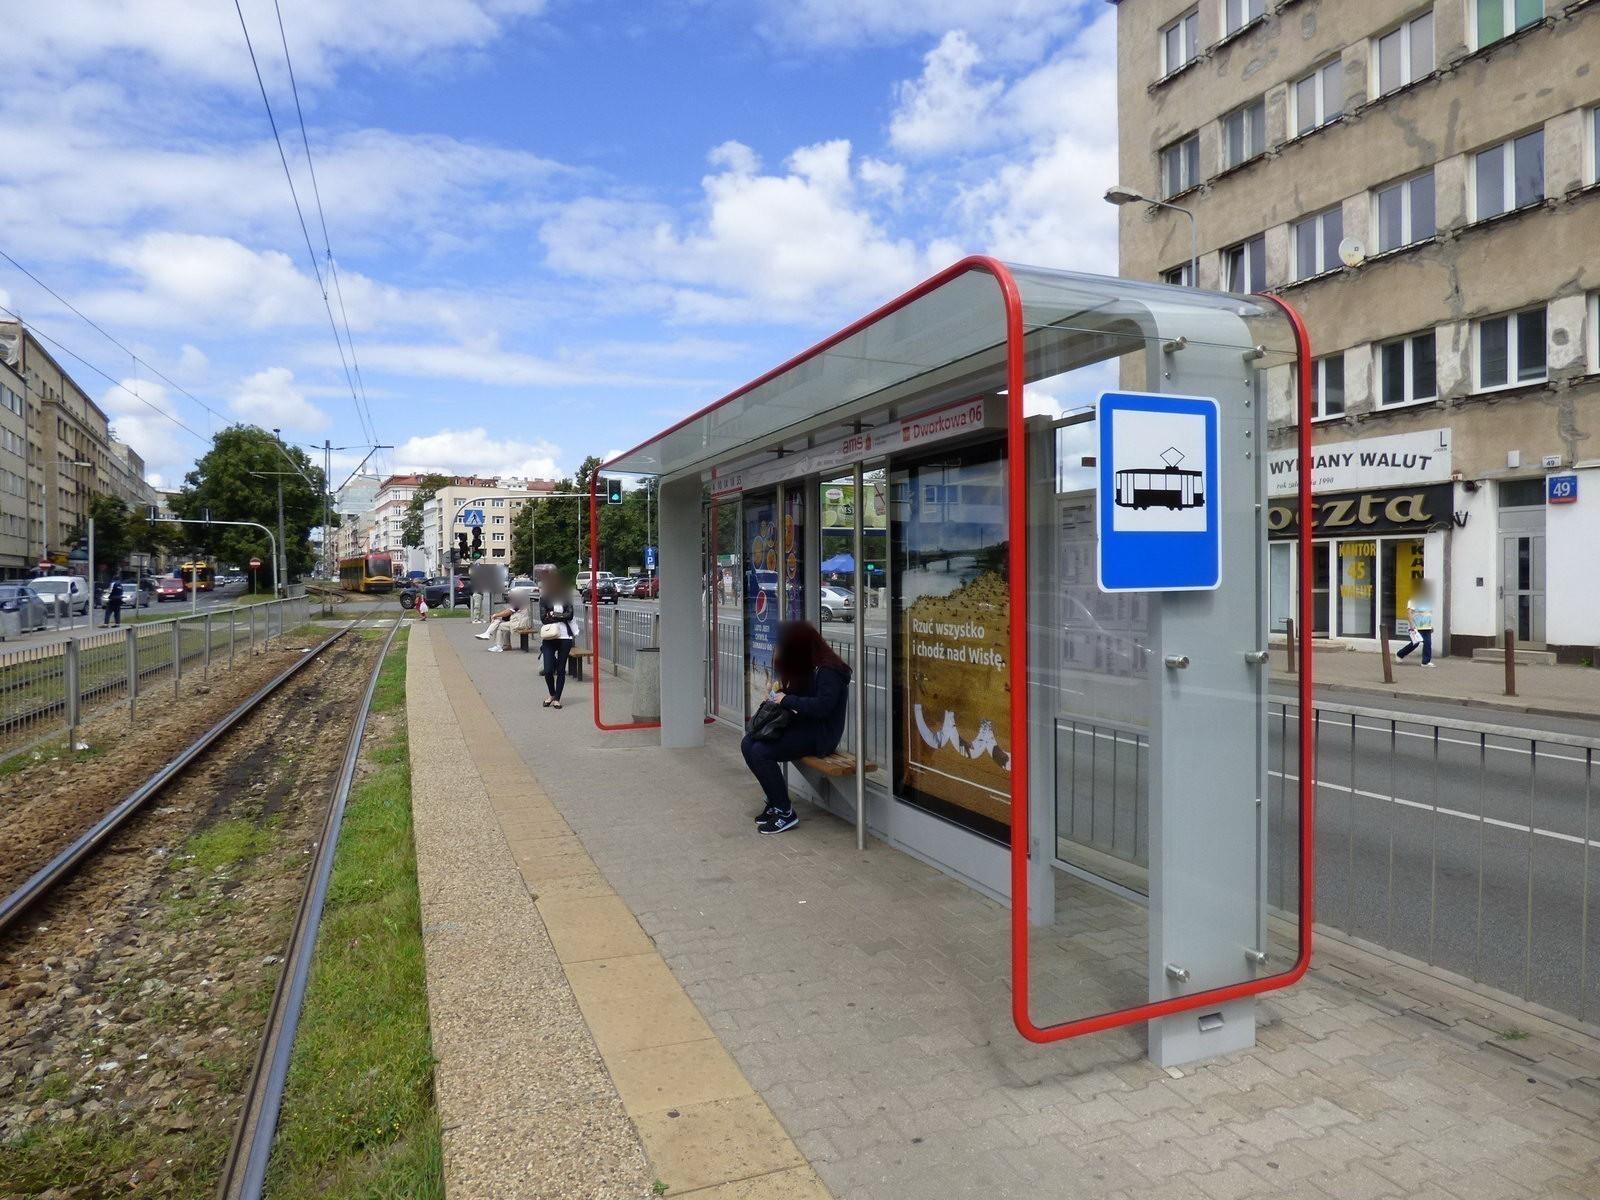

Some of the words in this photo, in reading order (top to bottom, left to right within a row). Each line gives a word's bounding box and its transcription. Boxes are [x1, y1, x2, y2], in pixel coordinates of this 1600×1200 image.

[913, 414, 967, 439] Dworkowa
[968, 405, 982, 424] 06
[842, 436, 863, 454] ams
[1270, 453, 1354, 475] WYIANY
[1360, 452, 1432, 471] WALUT
[1552, 482, 1570, 497] 49
[647, 556, 654, 565] P
[1347, 561, 1366, 579] 45
[912, 618, 934, 635] Rzuć
[935, 621, 985, 640] wszystko
[912, 640, 916, 655] i
[917, 641, 945, 659] chodź
[946, 645, 966, 662] nad
